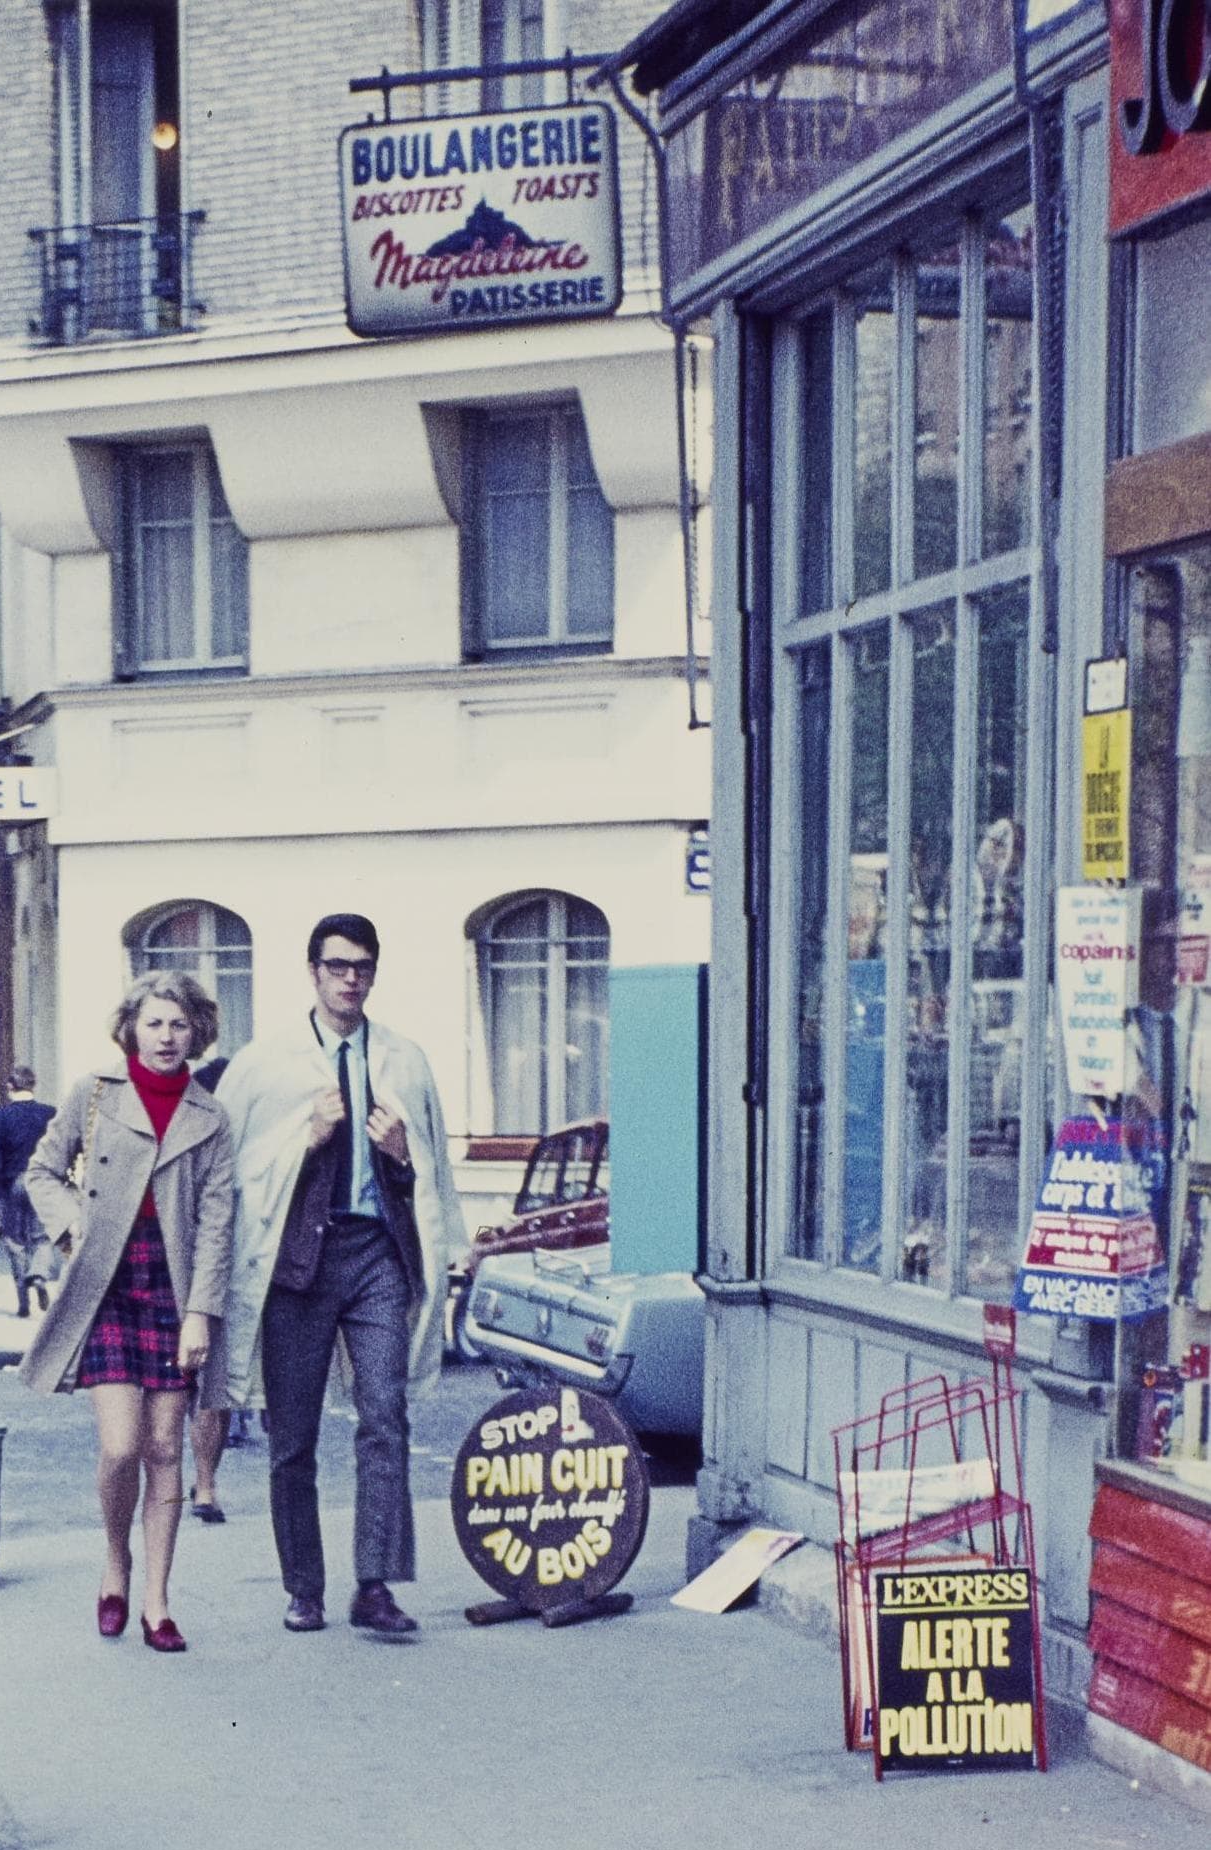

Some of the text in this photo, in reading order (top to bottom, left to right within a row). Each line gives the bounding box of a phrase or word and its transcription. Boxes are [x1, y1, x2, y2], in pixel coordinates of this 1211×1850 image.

[351, 114, 603, 187] BOULANGERIE
[352, 172, 601, 222] BISCOTTES TOASTS
[448, 276, 606, 317] PATISSERIE
[480, 1405, 559, 1450] STOP
[466, 1444, 629, 1498] PAIN CUIT
[482, 1519, 613, 1586] AU BOIS
[882, 1572, 1030, 1608] L'EXPRESS
[900, 1616, 1011, 1671] ALERTE
[925, 1669, 985, 1704] A LA
[879, 1696, 1033, 1758] POLLUTION
